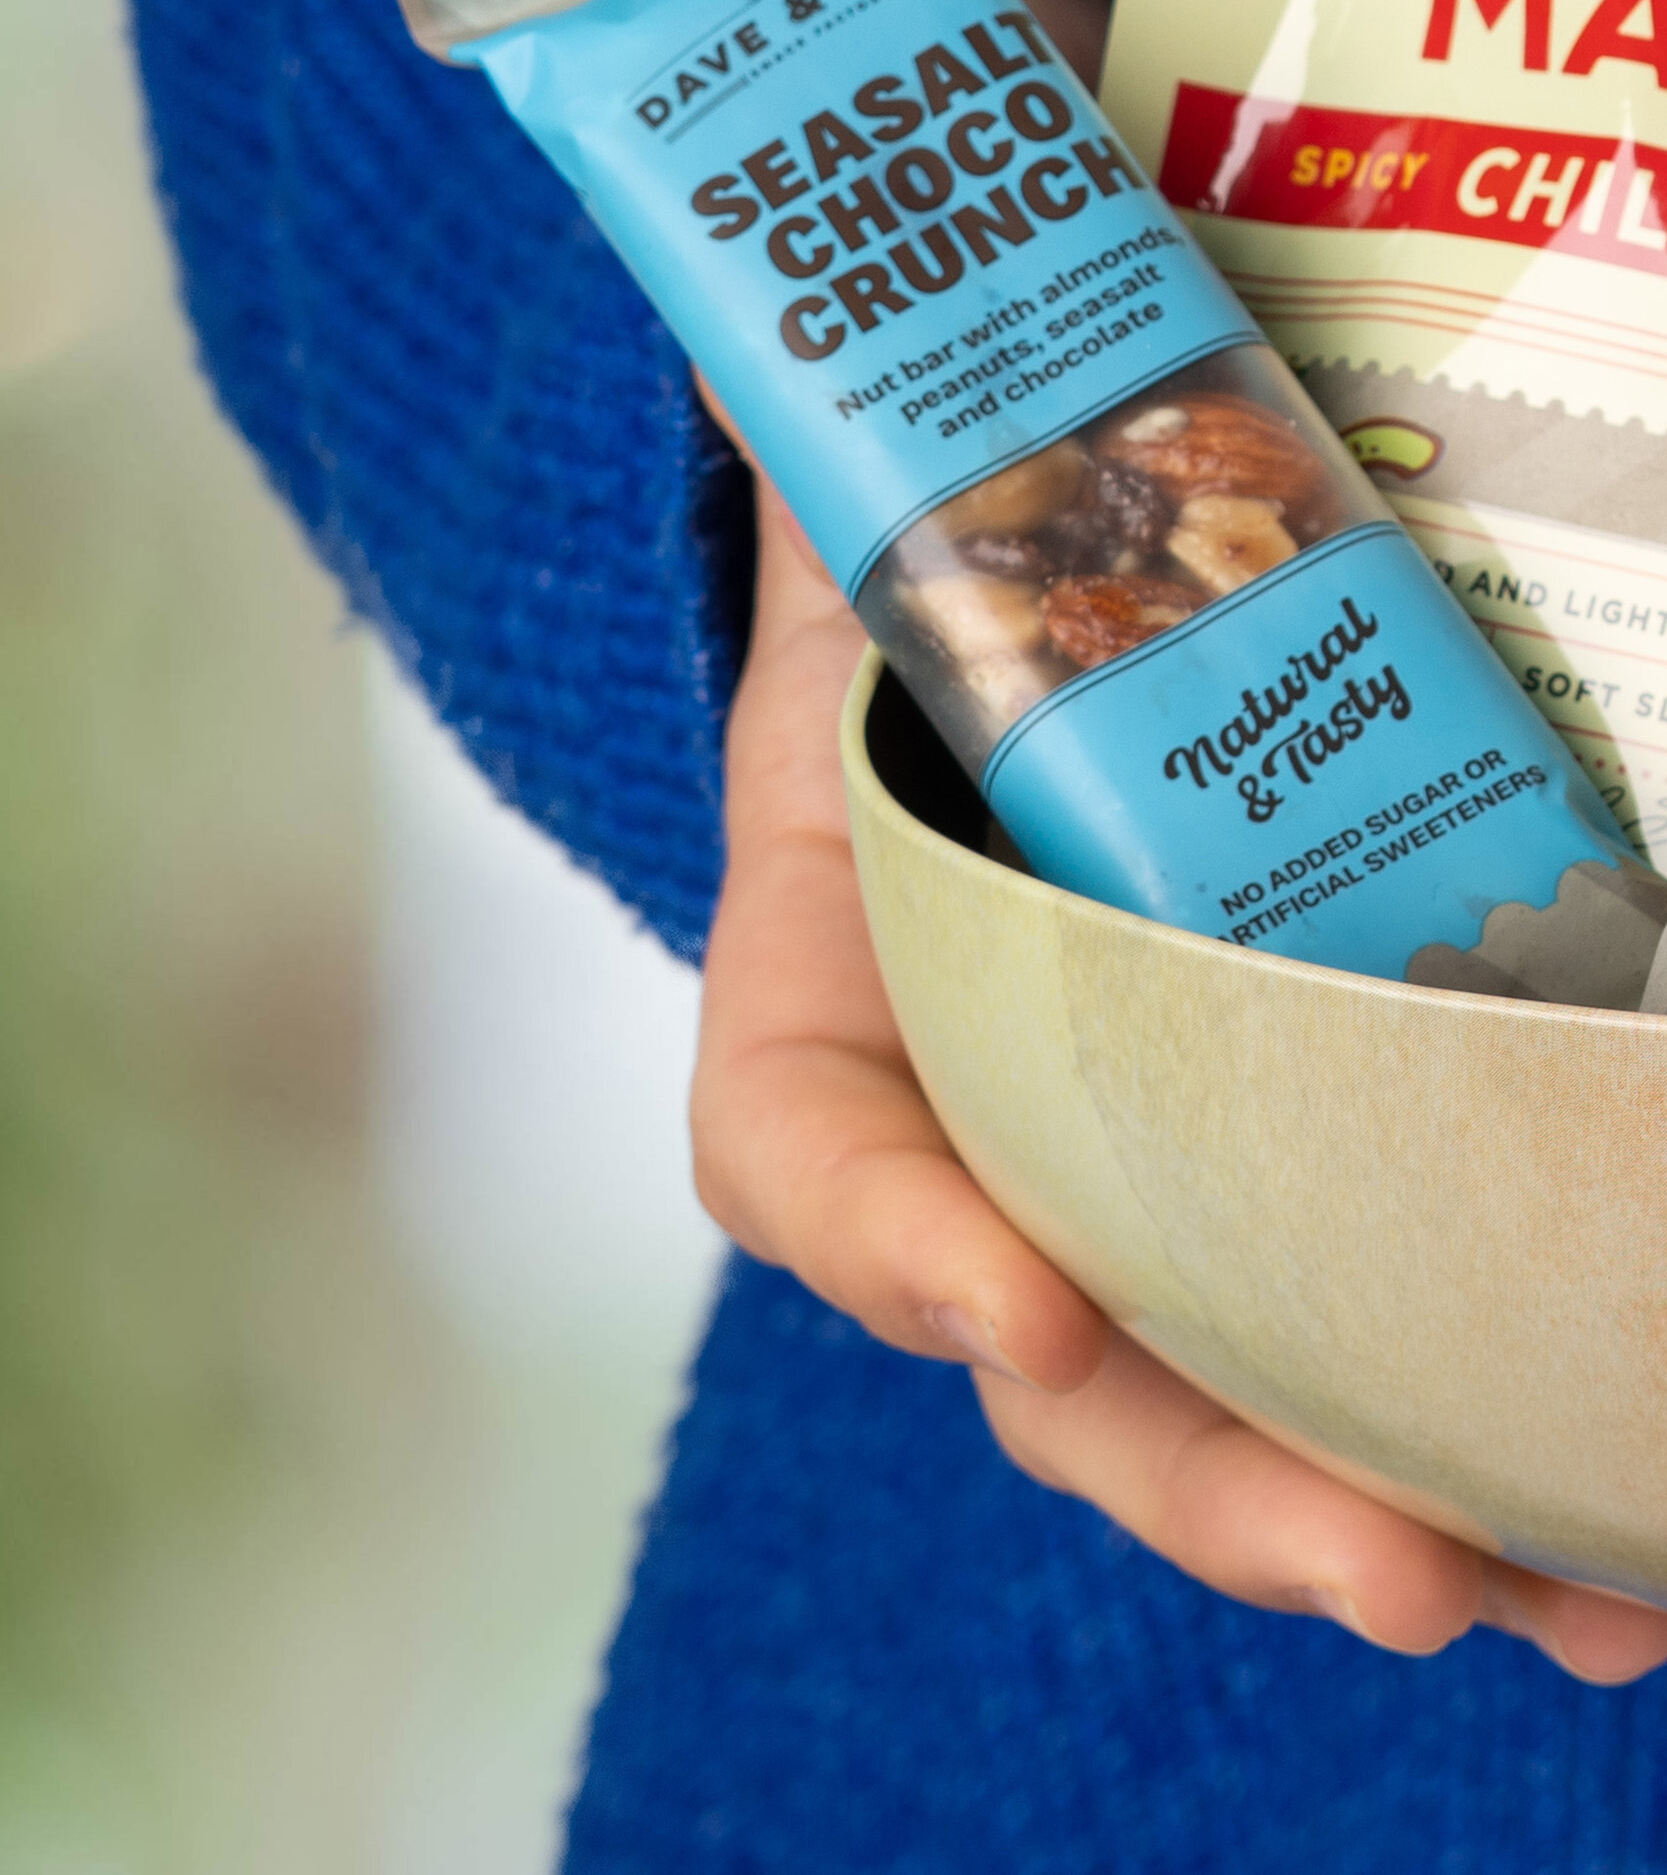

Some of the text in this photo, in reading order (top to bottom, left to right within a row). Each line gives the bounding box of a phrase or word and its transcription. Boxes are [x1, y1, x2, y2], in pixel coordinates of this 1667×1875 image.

[635, 20, 771, 130] DAVE
[690, 9, 1057, 242] SEASALT
[765, 81, 1074, 280] CHOCO
[1288, 144, 1430, 192] SPICY
[779, 135, 1148, 364] CRUNCH
[834, 367, 901, 422] Nut
[899, 339, 956, 382] bar
[960, 297, 1039, 349] with
[899, 262, 1165, 425] peanuts, seasalt
[936, 300, 1165, 439] and chocolate
[1467, 569, 1548, 608] AND
[1163, 596, 1379, 789] Natural
[1522, 665, 1621, 710] SOFT
[1219, 747, 1508, 918] NO ADDED SUGAR OR
[1362, 764, 1549, 875] SWEETENERS
